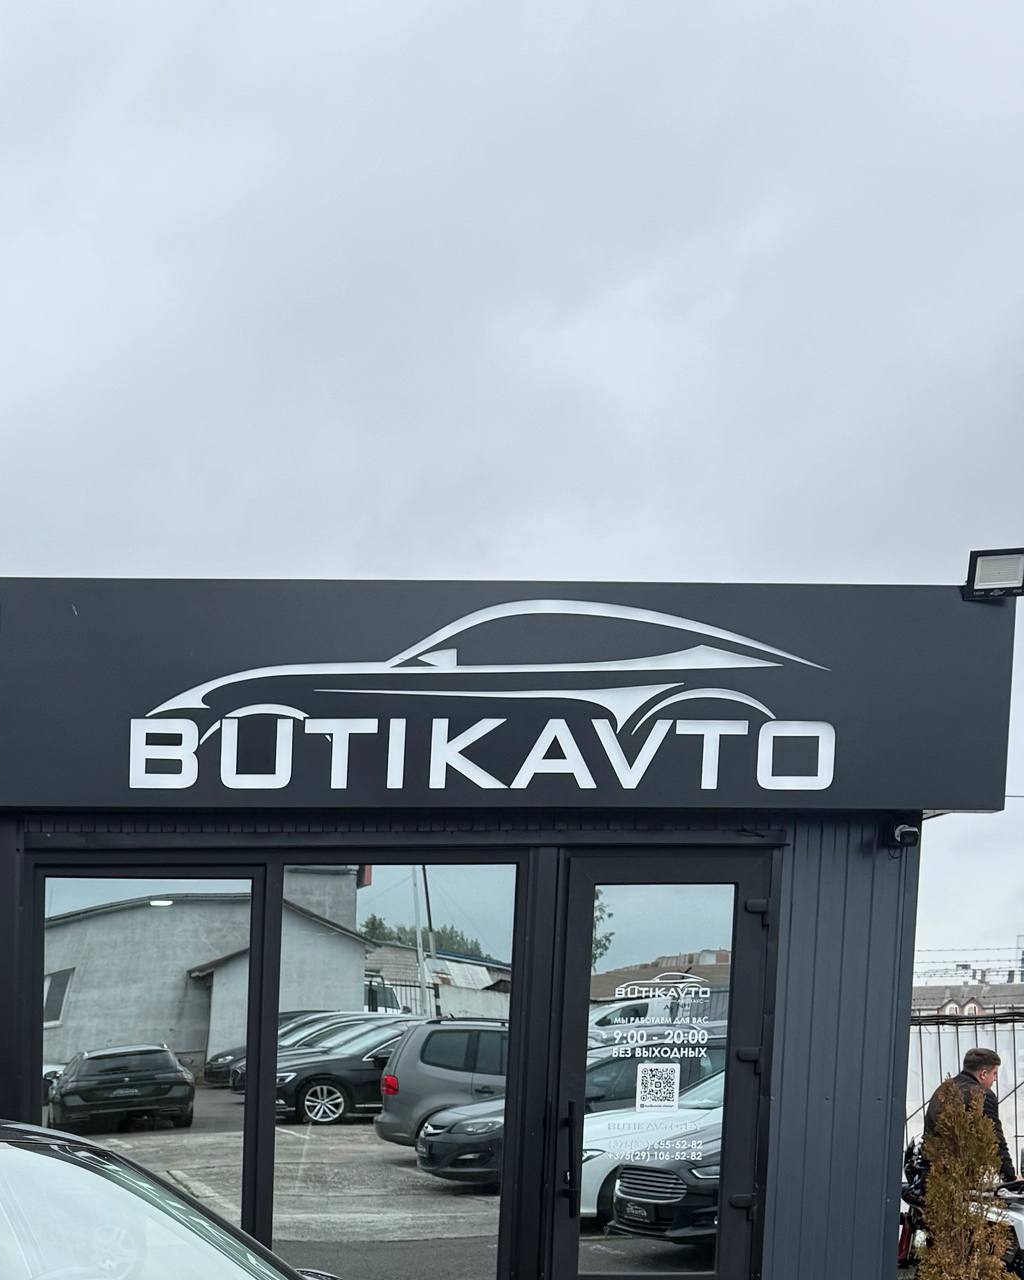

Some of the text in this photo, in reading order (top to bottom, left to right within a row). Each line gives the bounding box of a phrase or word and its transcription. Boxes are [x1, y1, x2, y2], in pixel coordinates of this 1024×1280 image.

[128, 716, 836, 791] BUTIKAVTO
[615, 987, 710, 998] BUTIKAVTO
[673, 1017, 690, 1025] ДЛЯ
[692, 1016, 709, 1024] ВАС
[614, 1030, 647, 1044] 9:00
[664, 1030, 708, 1044] 20:00
[612, 1047, 707, 1059] БЕЗ ВЫХОДНЫХ
[653, 1140, 703, 1149] 655-52-82
[608, 1151, 703, 1162] +375(29) 106-52-82
